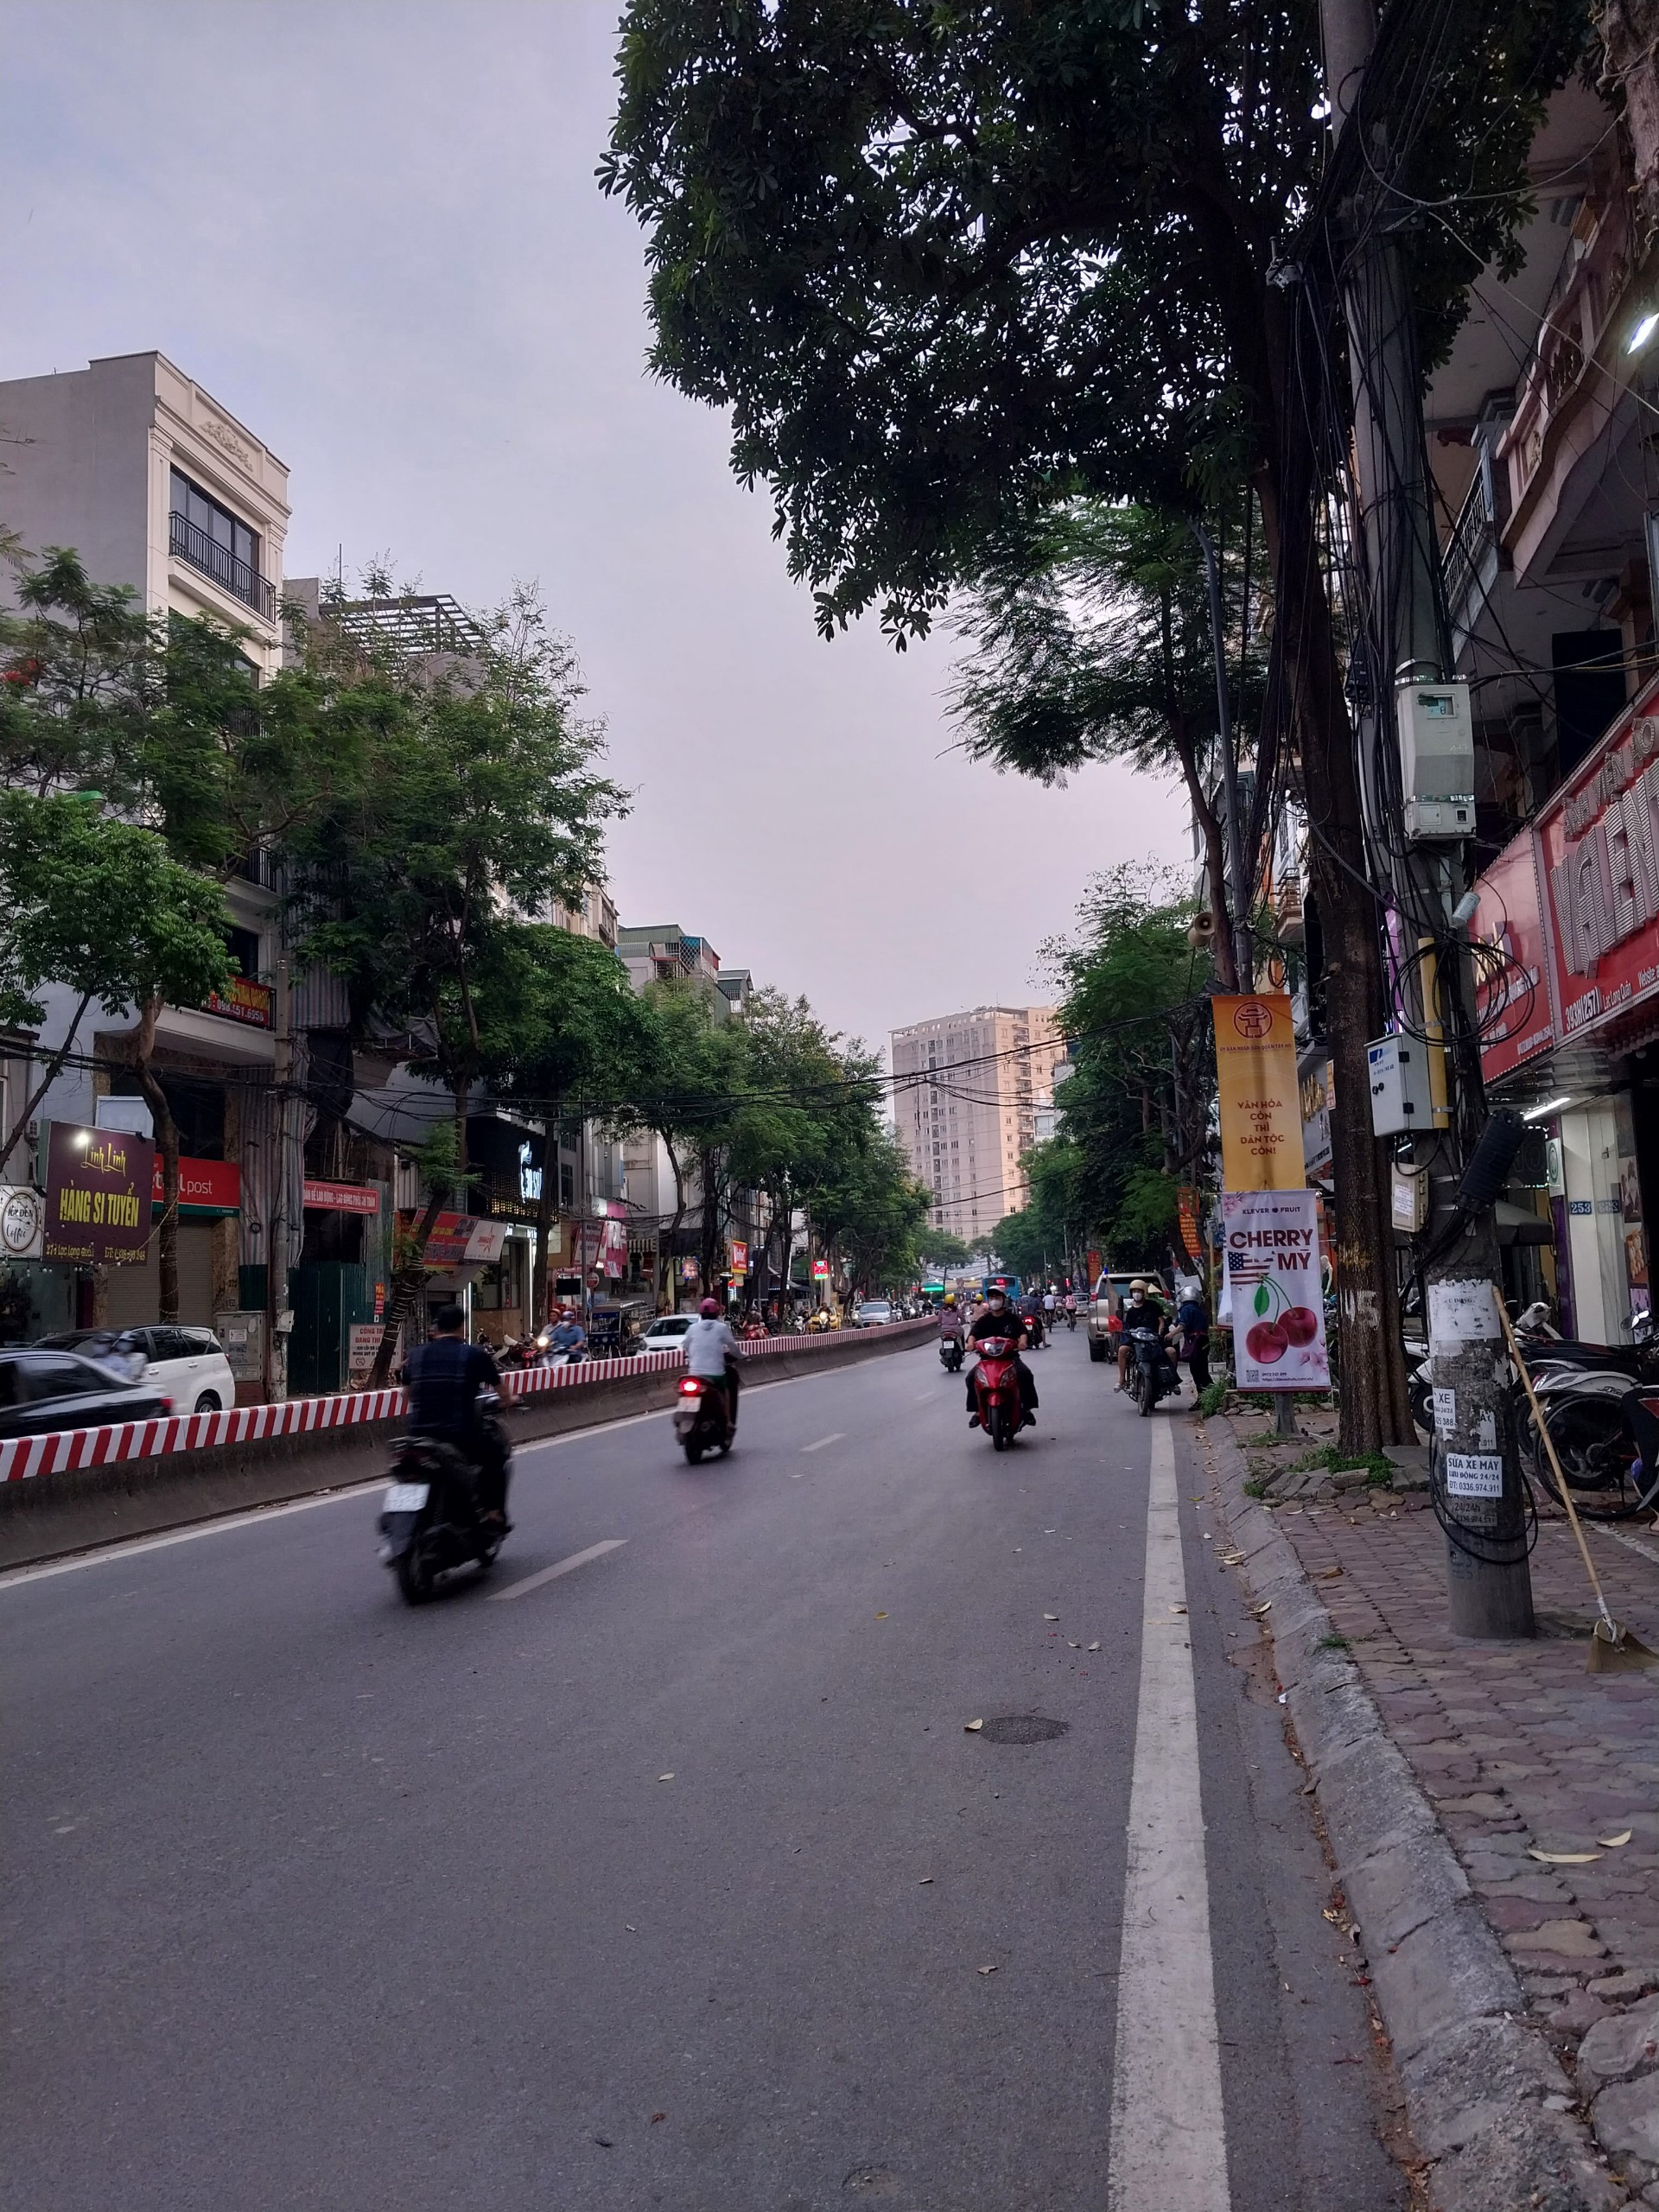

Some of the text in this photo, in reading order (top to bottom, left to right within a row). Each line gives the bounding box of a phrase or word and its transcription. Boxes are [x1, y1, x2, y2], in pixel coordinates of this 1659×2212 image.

[1550, 758, 1659, 979] VALEN
[1565, 986, 1601, 1031] 393H(257)
[1237, 1101, 1259, 1109] VĂN
[1264, 1133, 1285, 1145] TỘC
[187, 1180, 213, 1195] post
[59, 1179, 92, 1223] HÀNG
[1570, 1202, 1592, 1214] 253
[1230, 1229, 1313, 1249] CHERRY
[1277, 1249, 1312, 1271] MỸ
[1439, 1393, 1452, 1404] XE
[1448, 1455, 1499, 1471] SỬA XE MÁY
[1459, 1471, 1478, 1480] ĐỘNG
[1449, 1480, 1499, 1492] ĐT: 0336.974.911
